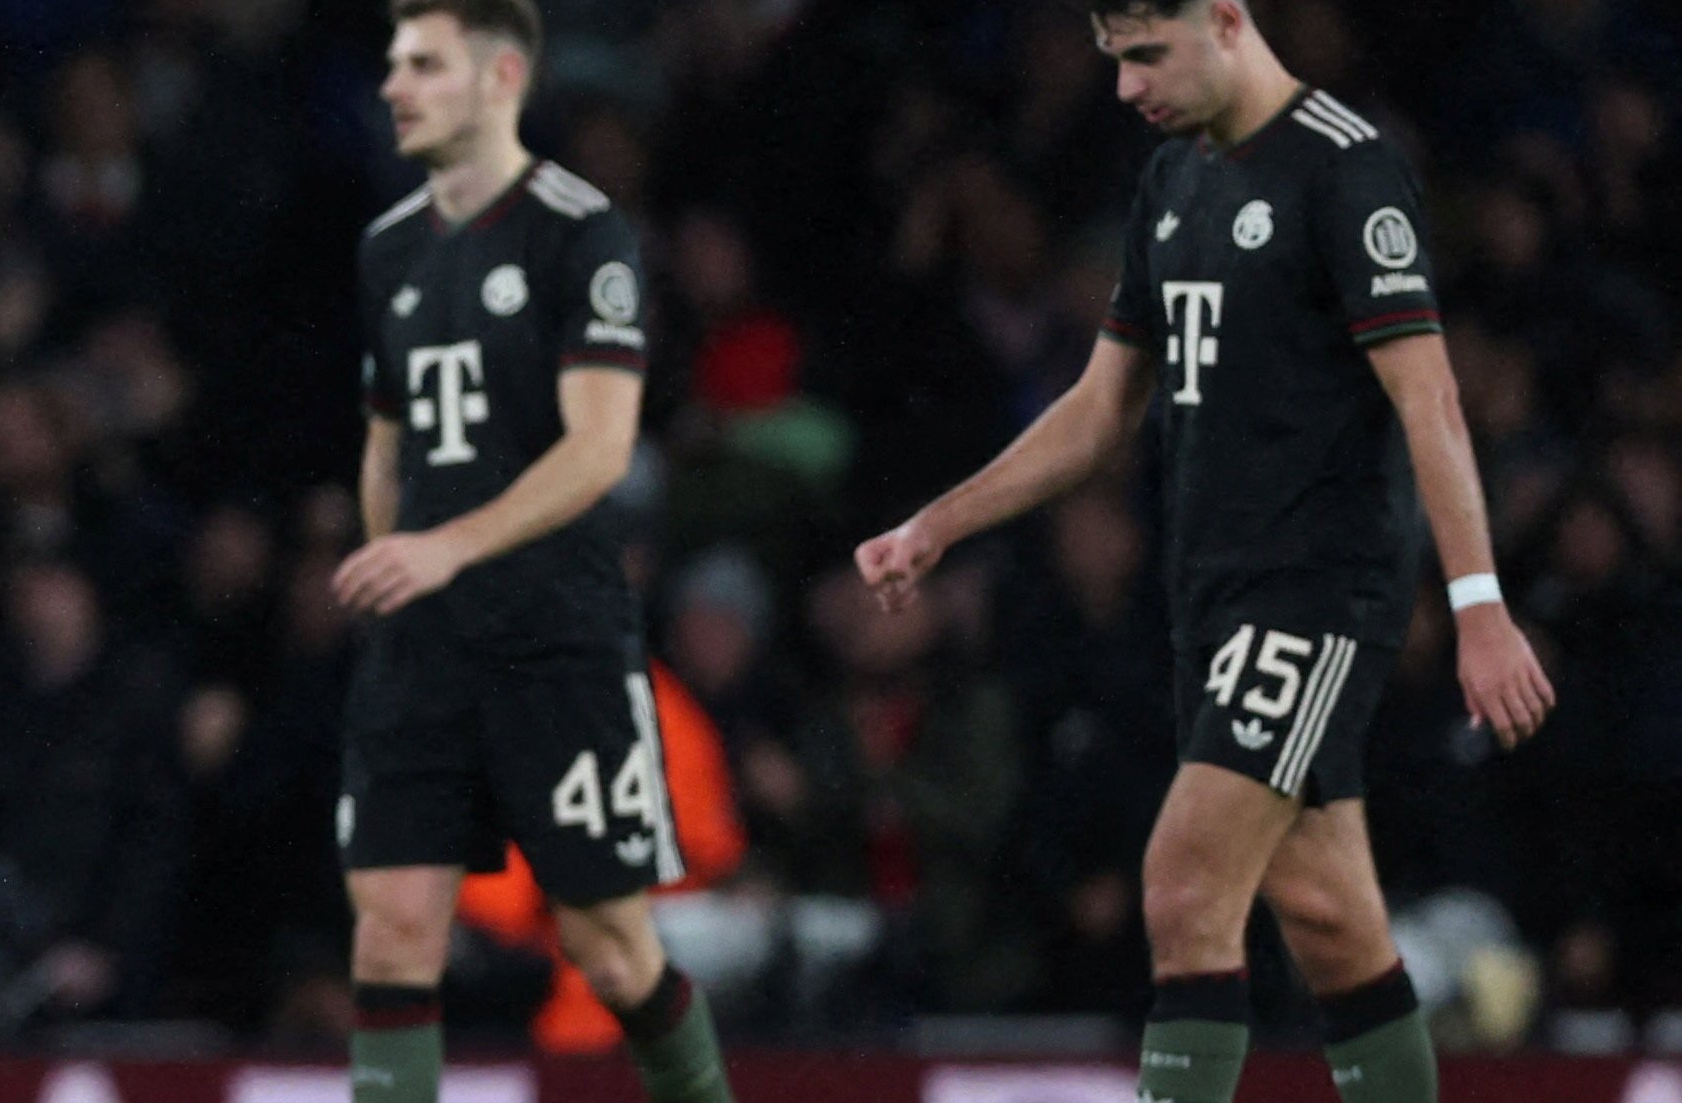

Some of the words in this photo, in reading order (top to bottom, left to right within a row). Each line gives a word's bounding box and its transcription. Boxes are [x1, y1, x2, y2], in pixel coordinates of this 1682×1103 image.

[1161, 280, 1224, 406] T
[407, 339, 489, 466] T
[1204, 623, 1313, 719] 45
[551, 740, 657, 839] 44
